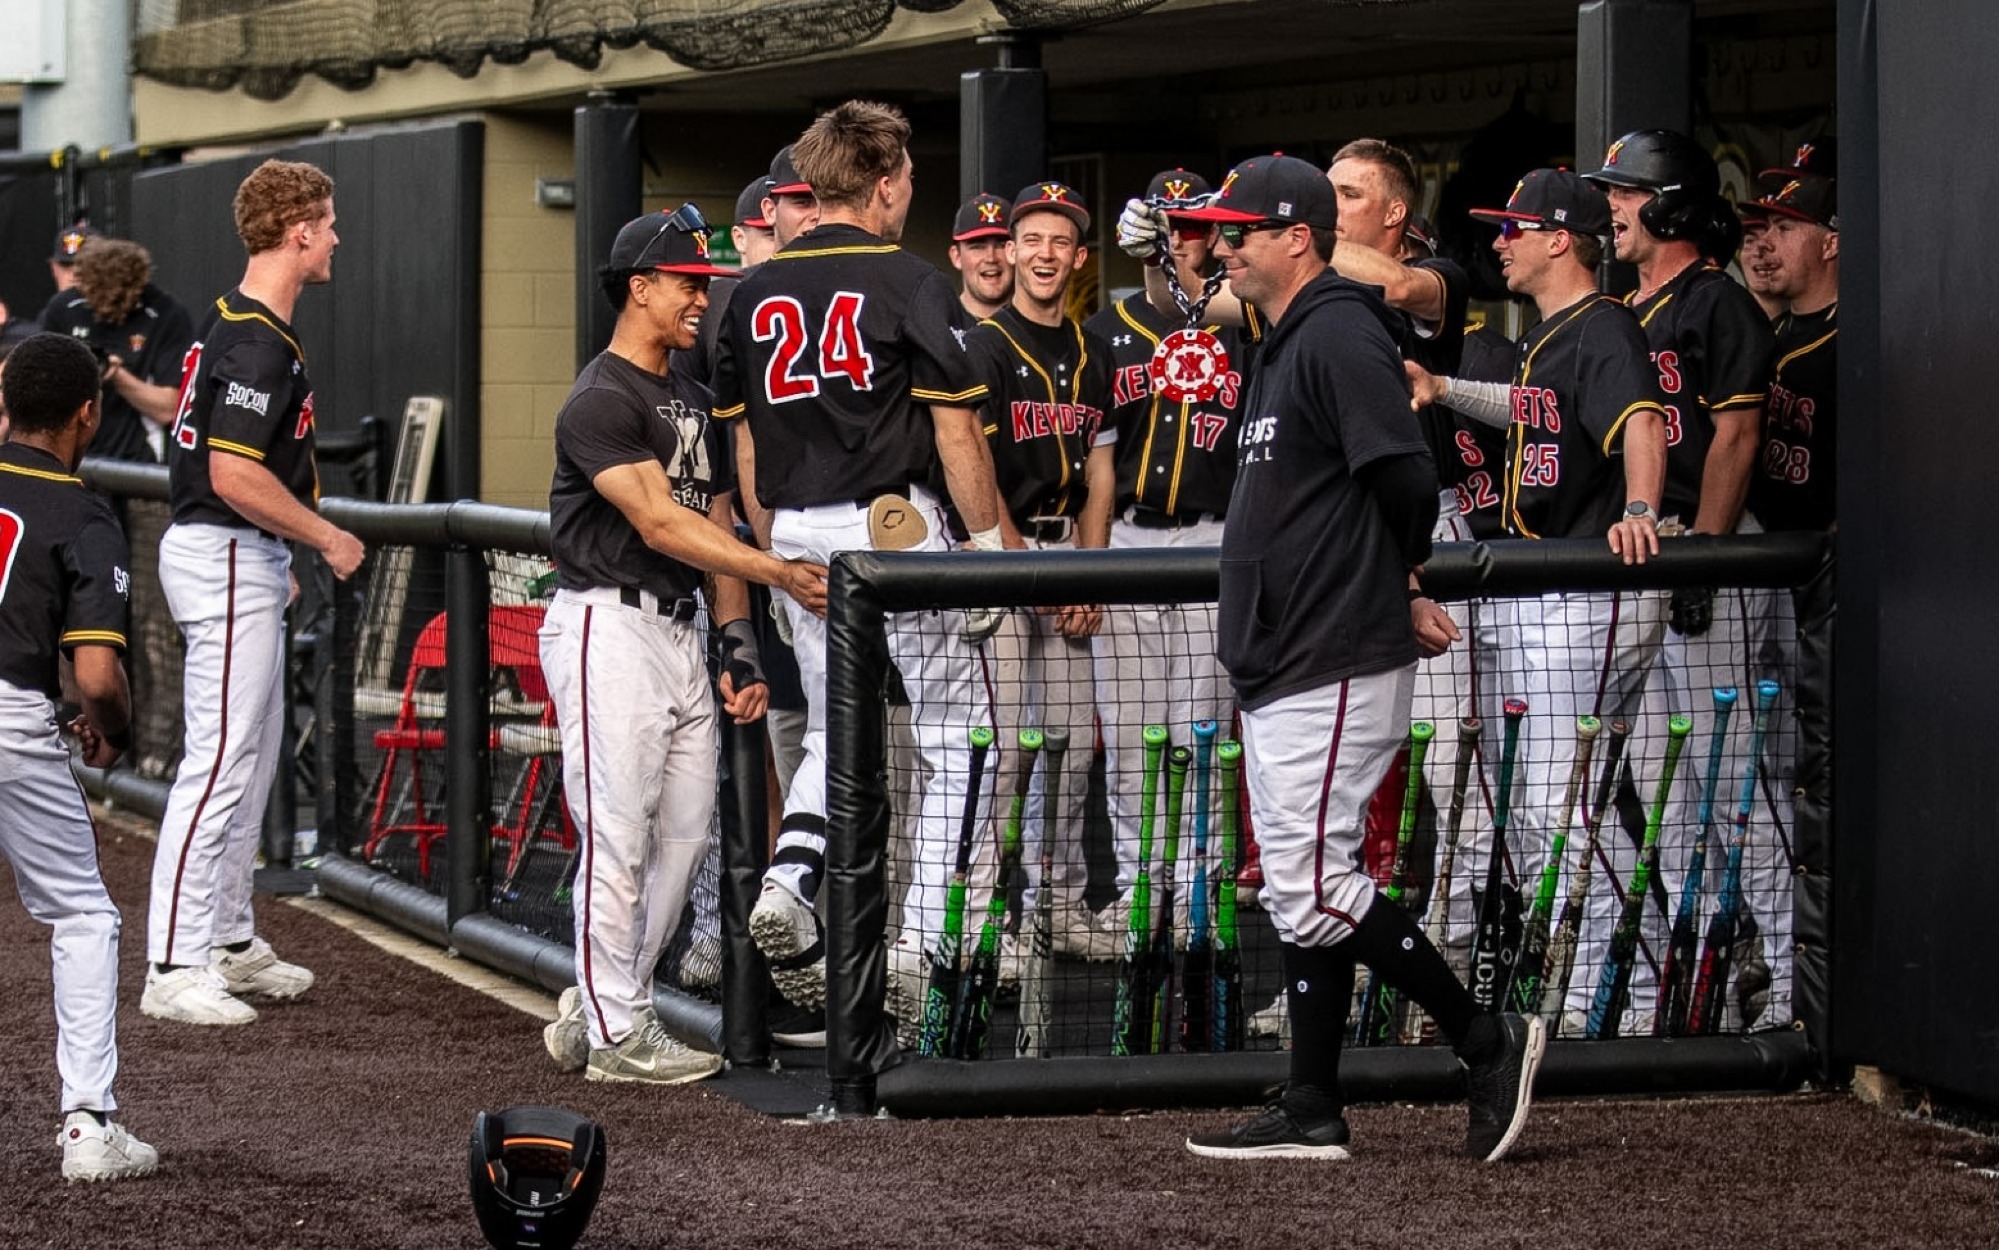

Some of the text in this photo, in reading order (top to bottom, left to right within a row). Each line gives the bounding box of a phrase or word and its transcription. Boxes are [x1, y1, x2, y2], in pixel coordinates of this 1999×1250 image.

[751, 291, 875, 405] 24
[1191, 411, 1228, 452] 17
[1521, 443, 1558, 486] 25
